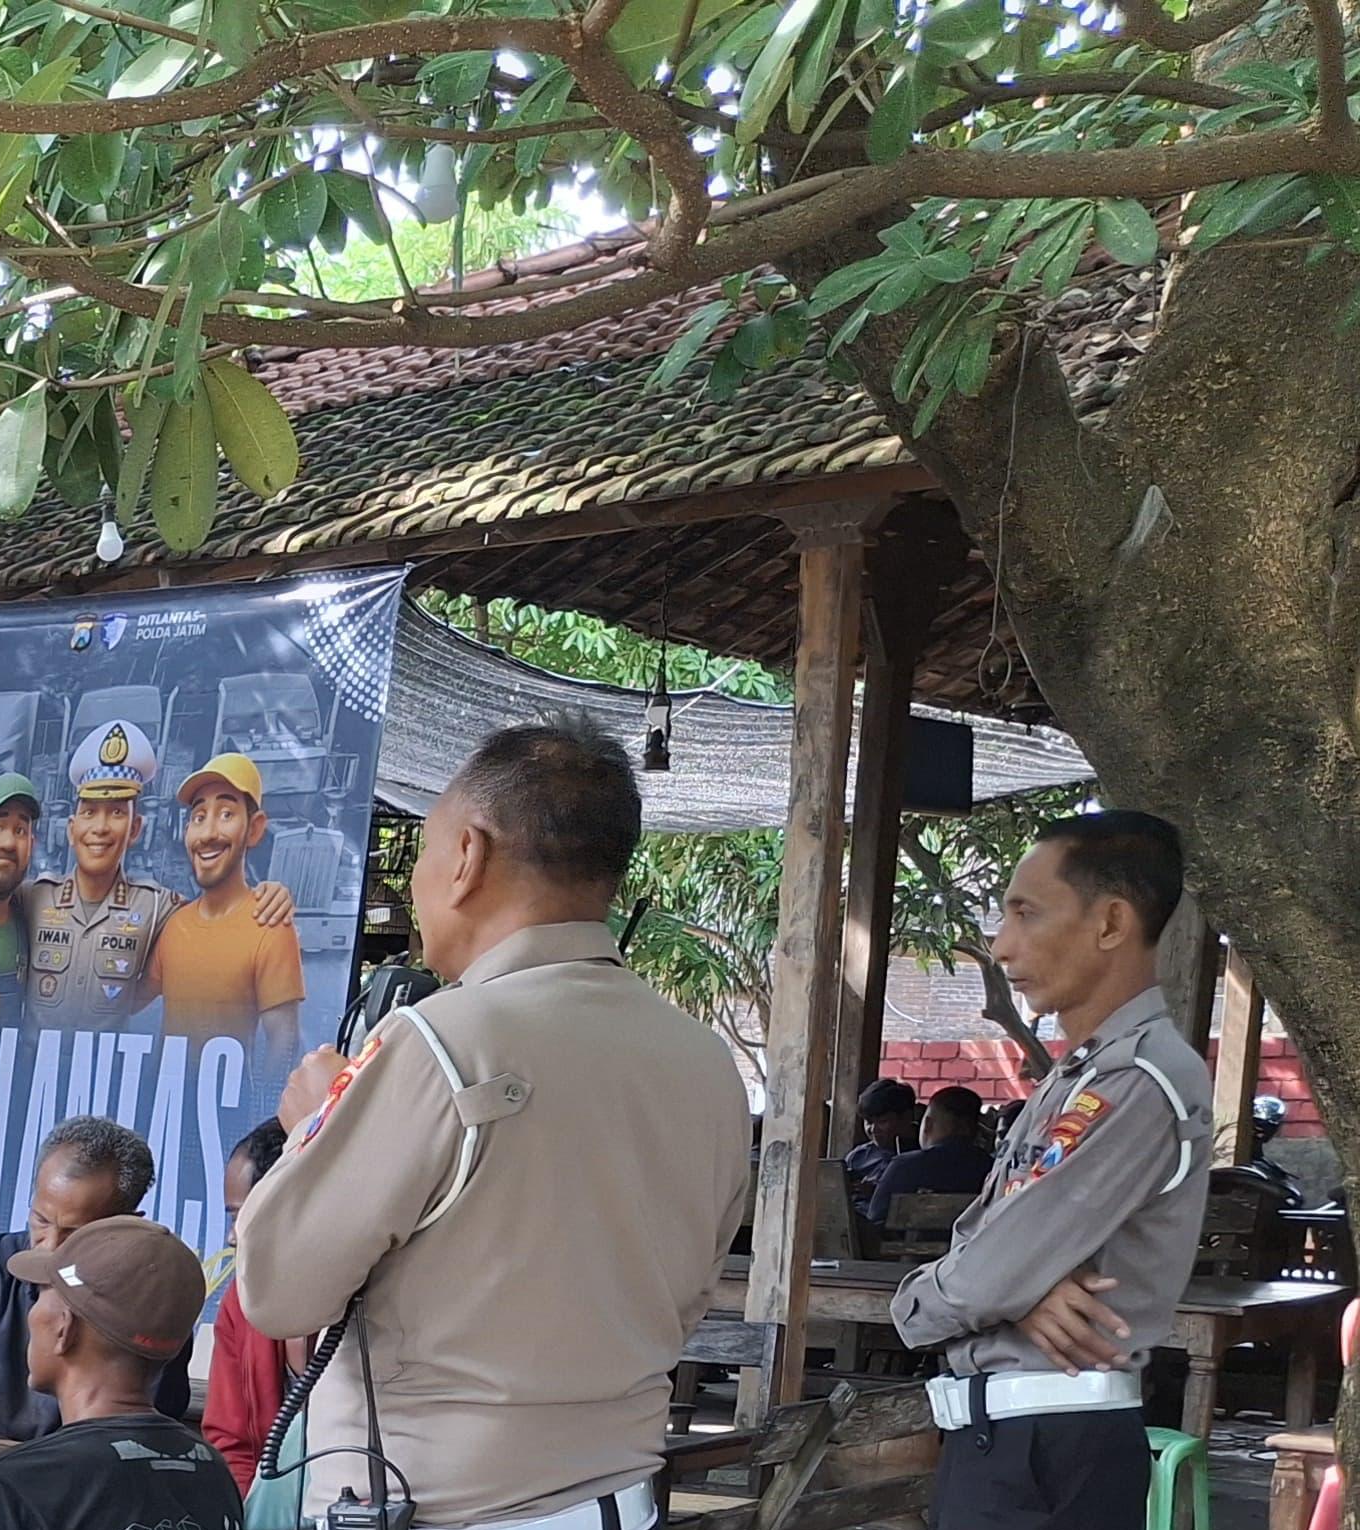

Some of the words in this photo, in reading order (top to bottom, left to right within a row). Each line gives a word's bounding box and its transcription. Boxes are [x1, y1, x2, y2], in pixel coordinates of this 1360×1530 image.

[137, 611, 200, 626] DITLANTAS
[135, 625, 171, 641] POLDA
[174, 623, 206, 638] JATIM
[37, 930, 70, 944] IWAN
[101, 936, 138, 951] POLRI
